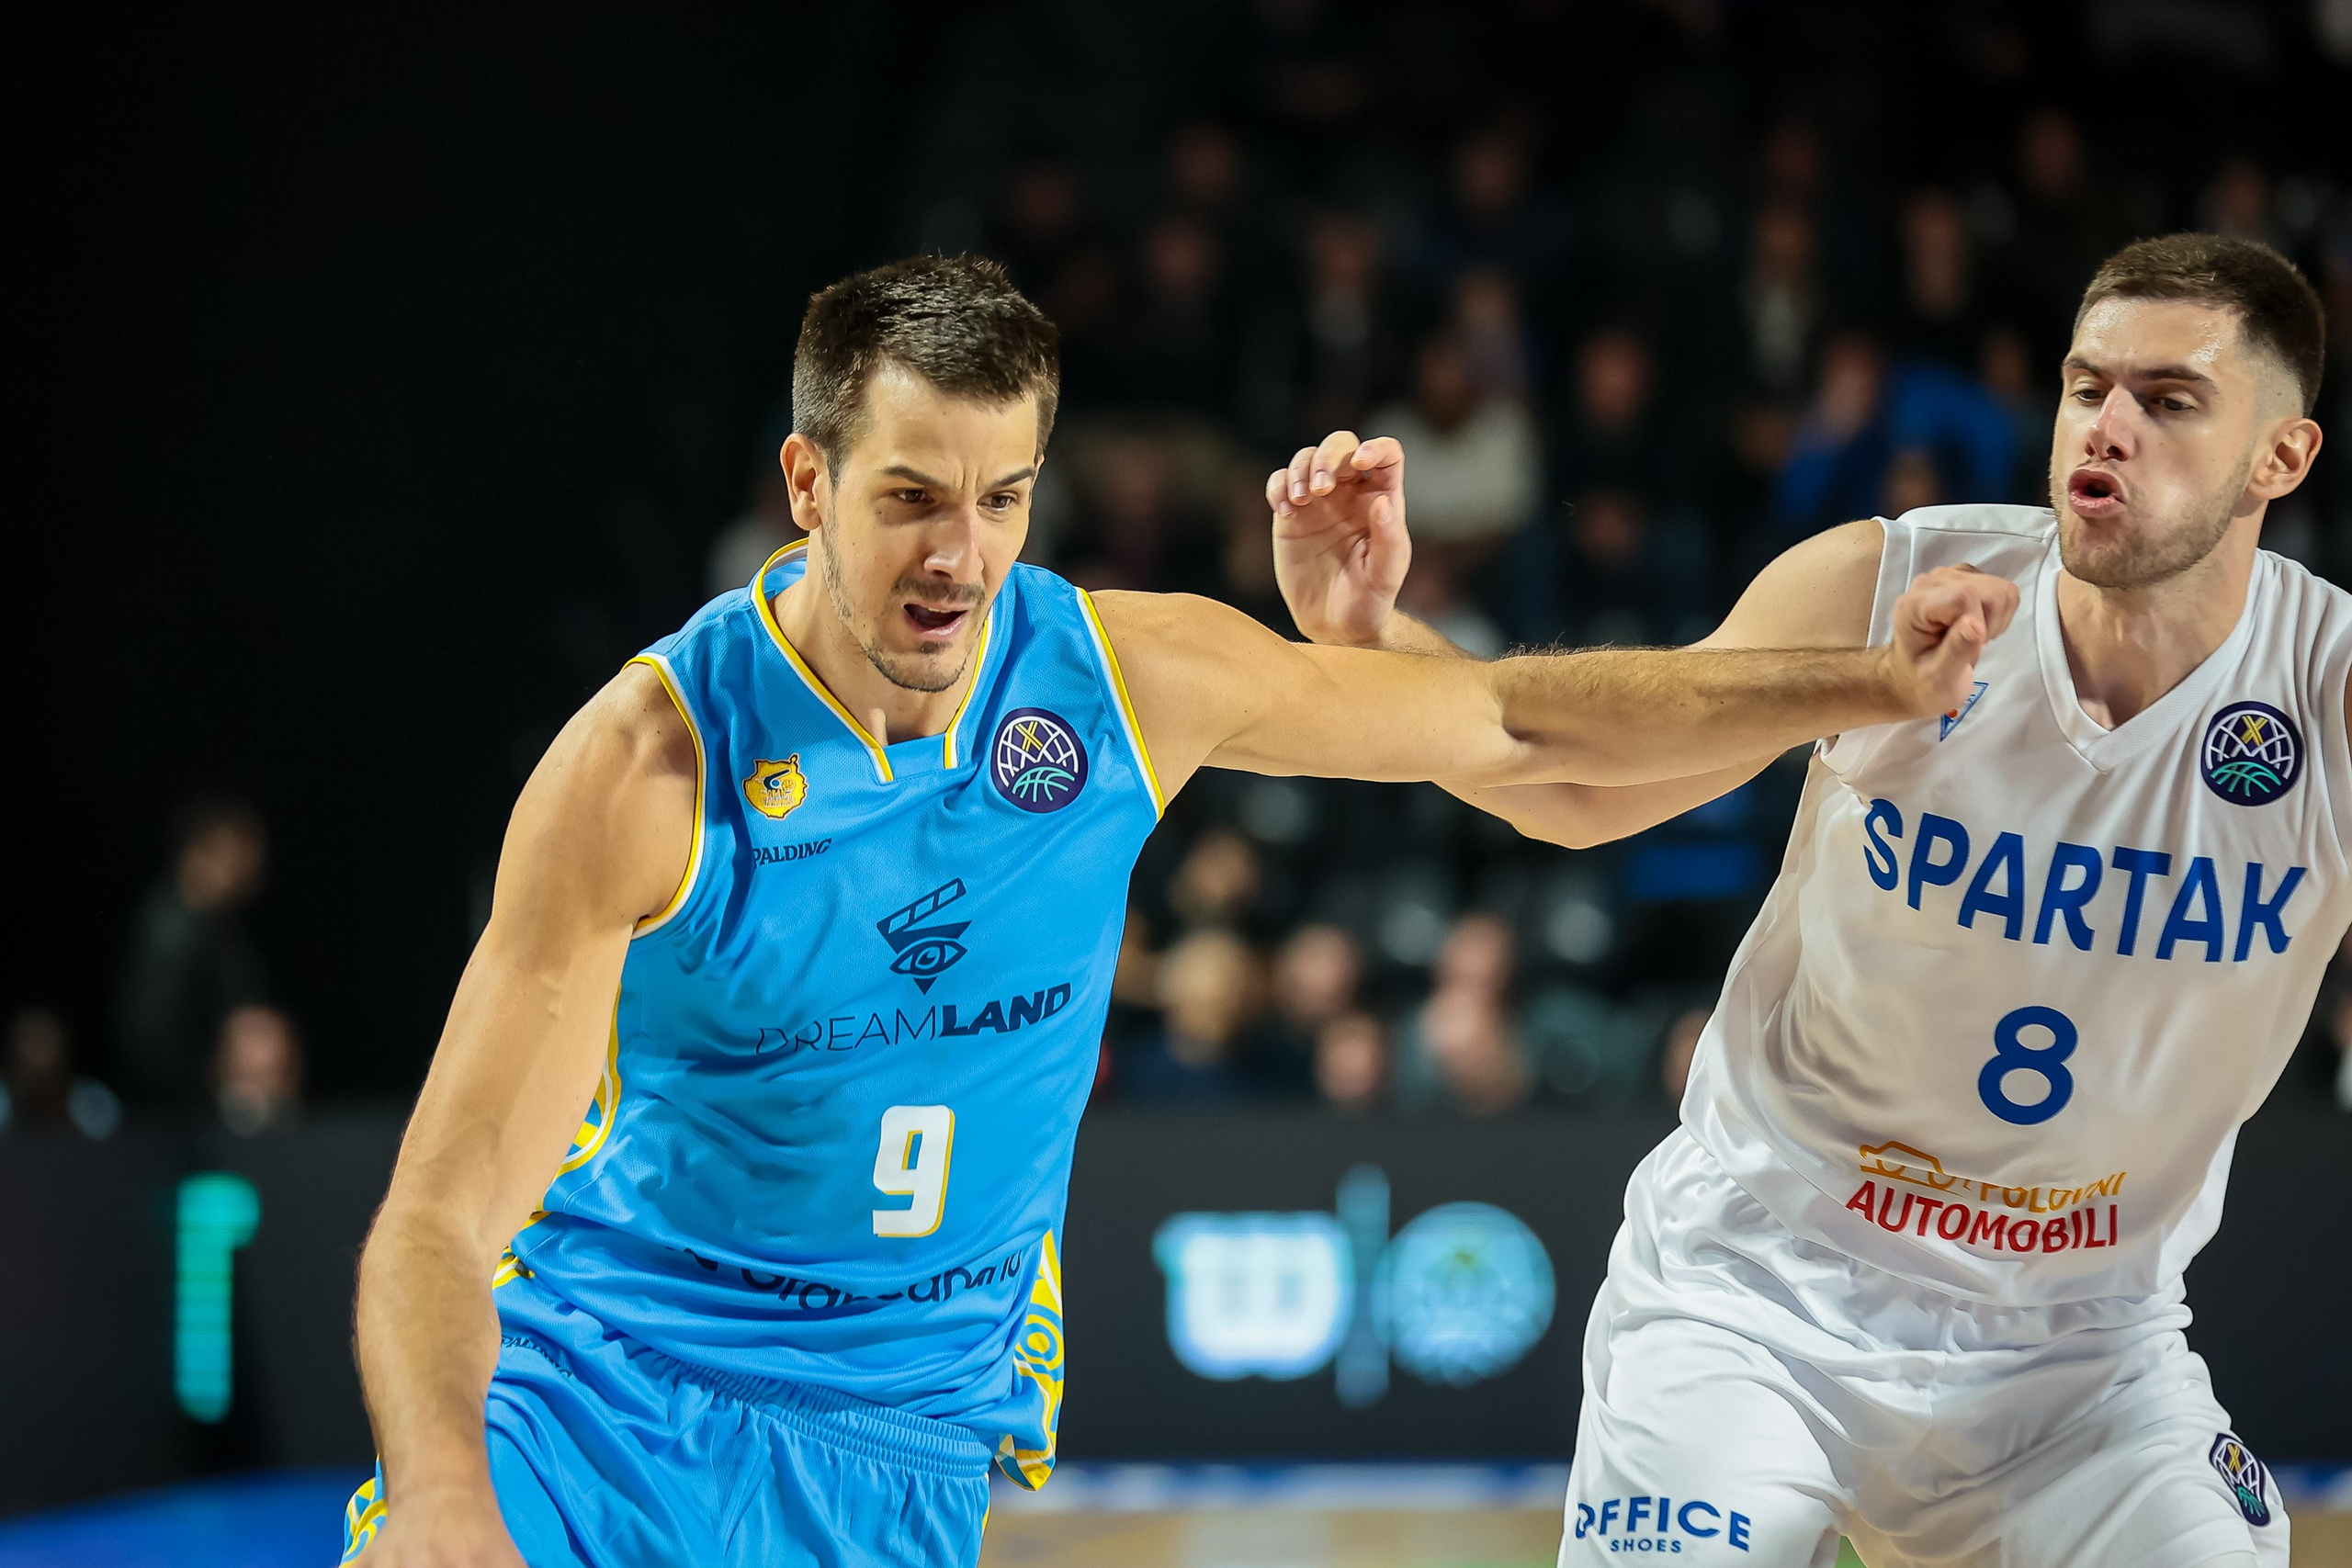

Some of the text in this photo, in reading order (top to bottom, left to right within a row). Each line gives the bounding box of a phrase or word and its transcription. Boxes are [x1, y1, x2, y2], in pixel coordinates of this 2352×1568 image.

[752, 838, 832, 869] PALDING
[1862, 797, 2308, 964] SPARTAK
[755, 981, 1072, 1055] DREAMLAND
[1977, 1005, 2079, 1126] 8
[872, 1104, 956, 1238] 9
[1845, 1179, 2119, 1254] AUTOMOBILI
[1575, 1495, 1752, 1553] OFFICE
[1610, 1538, 1683, 1553] SHOES
